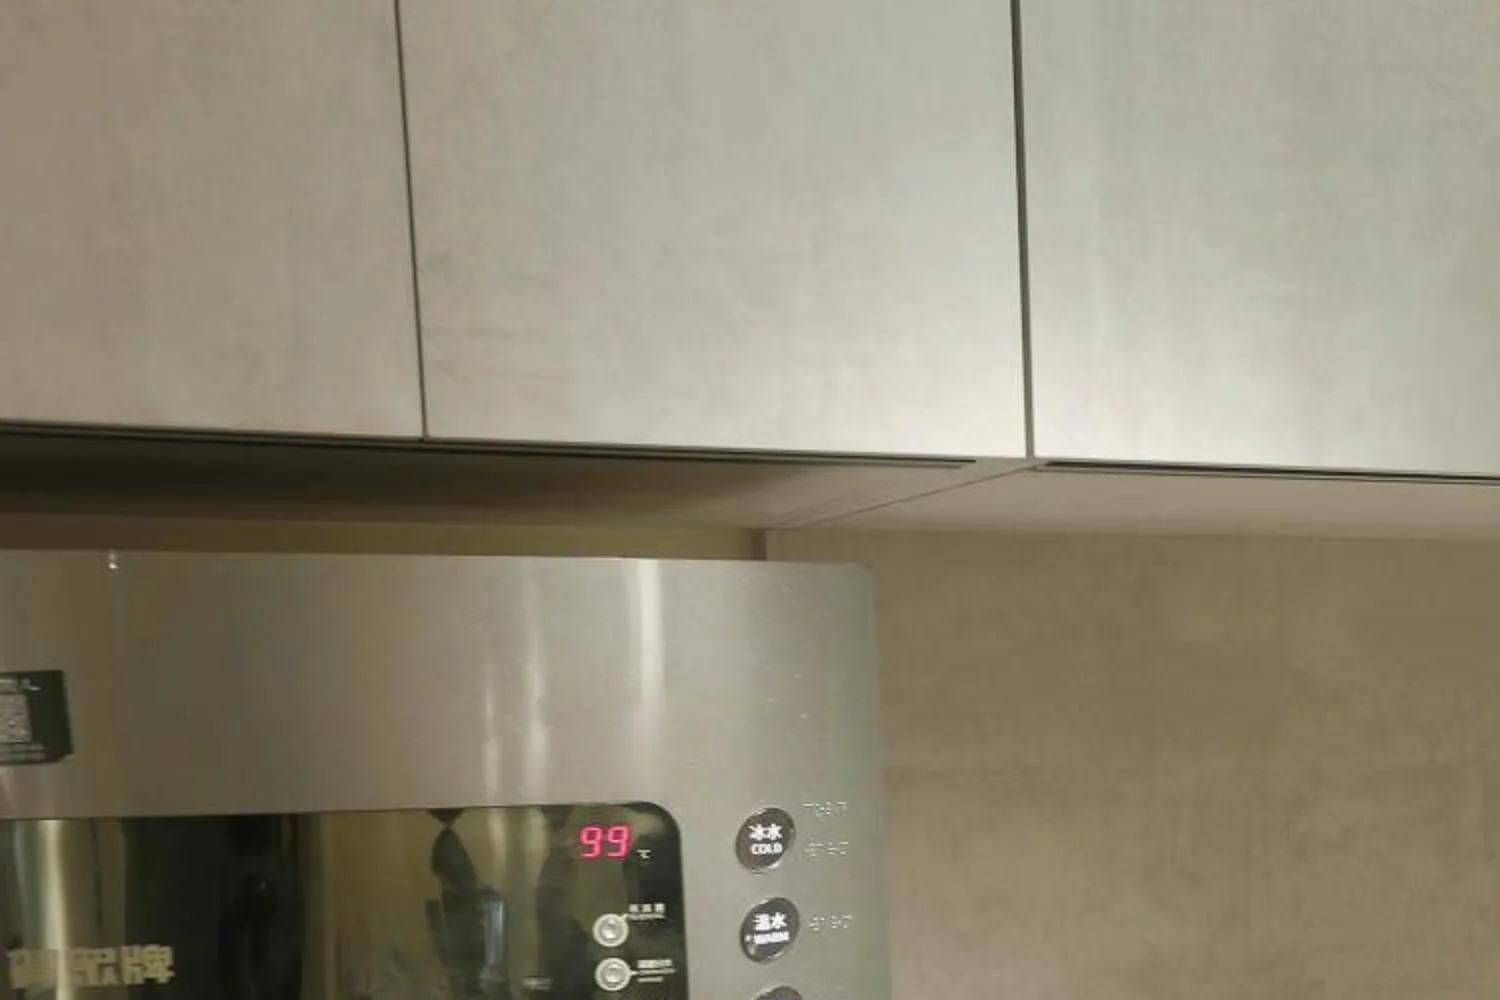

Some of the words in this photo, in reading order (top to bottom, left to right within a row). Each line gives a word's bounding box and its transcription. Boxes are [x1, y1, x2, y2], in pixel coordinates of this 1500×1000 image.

[748, 823, 783, 841] 冰水
[579, 824, 631, 859] 99
[750, 842, 783, 855] COLD
[754, 931, 790, 944] WARM
